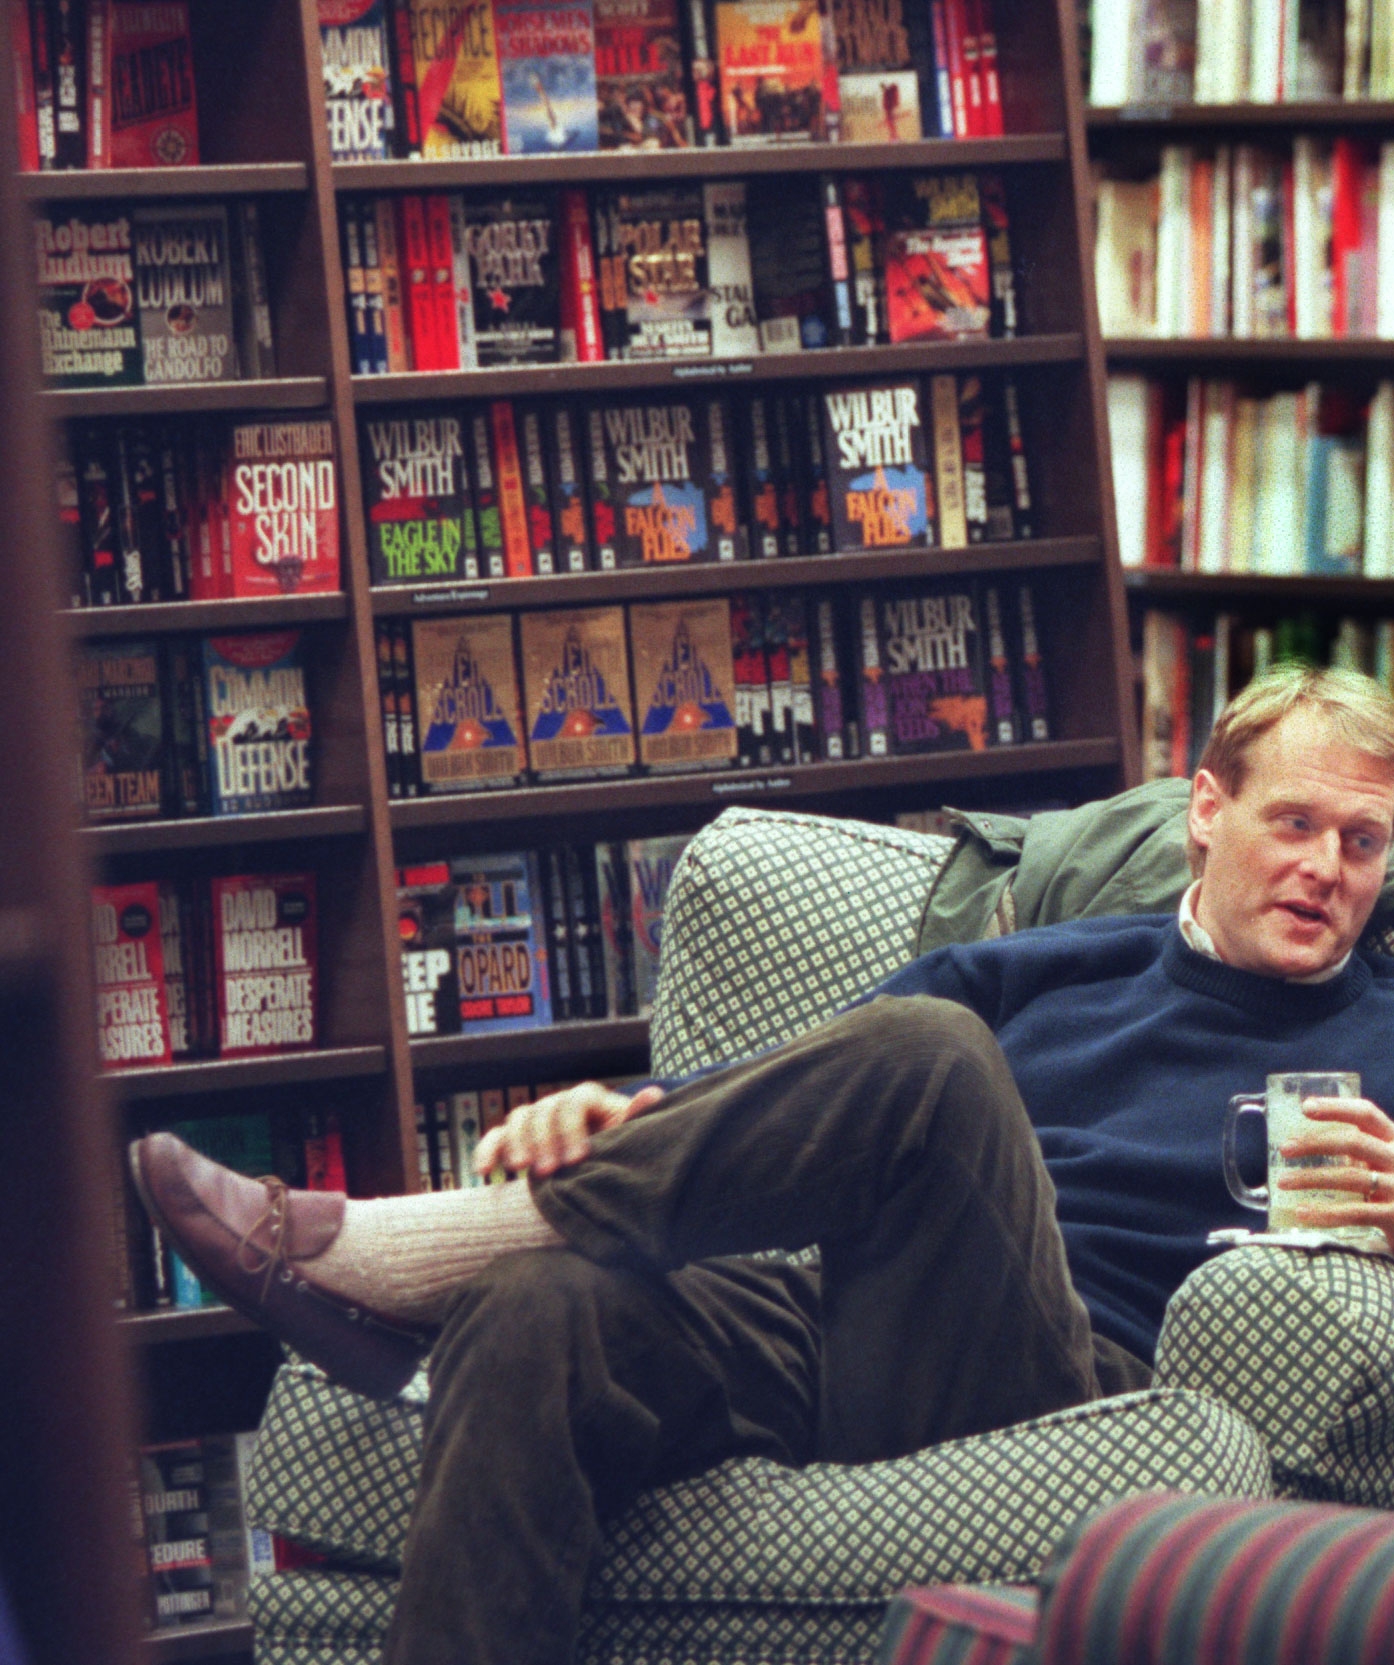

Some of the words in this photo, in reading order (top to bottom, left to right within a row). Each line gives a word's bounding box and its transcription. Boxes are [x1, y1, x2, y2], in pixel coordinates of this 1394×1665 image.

[36, 217, 131, 251] Robert
[167, 335, 209, 357] ROAD
[211, 333, 228, 355] TO
[144, 356, 222, 382] GANDOLFO
[604, 404, 696, 446] WILBUR
[825, 387, 921, 432] WILBUR
[367, 417, 463, 461] WILBUR
[838, 425, 914, 470] SMITH
[379, 456, 455, 499] SMITH
[616, 441, 690, 484] SMITH
[235, 460, 335, 515] SECOND
[255, 511, 318, 565] SKIN
[380, 519, 439, 551] EAGLE
[441, 518, 461, 543] IN
[384, 546, 421, 578] THE
[424, 543, 461, 575] SKY
[884, 595, 976, 634] WILBUR
[887, 630, 969, 675] SMITH
[209, 665, 307, 717] COMMON
[215, 738, 311, 798] DEFENSE
[402, 948, 450, 991] EP
[458, 942, 533, 997] OPARD
[100, 986, 162, 1026] PERATE
[225, 972, 312, 1013] DESPERATE
[406, 990, 438, 1034] IE
[222, 1007, 313, 1049] MEASURES
[152, 1538, 206, 1566] EDURE
